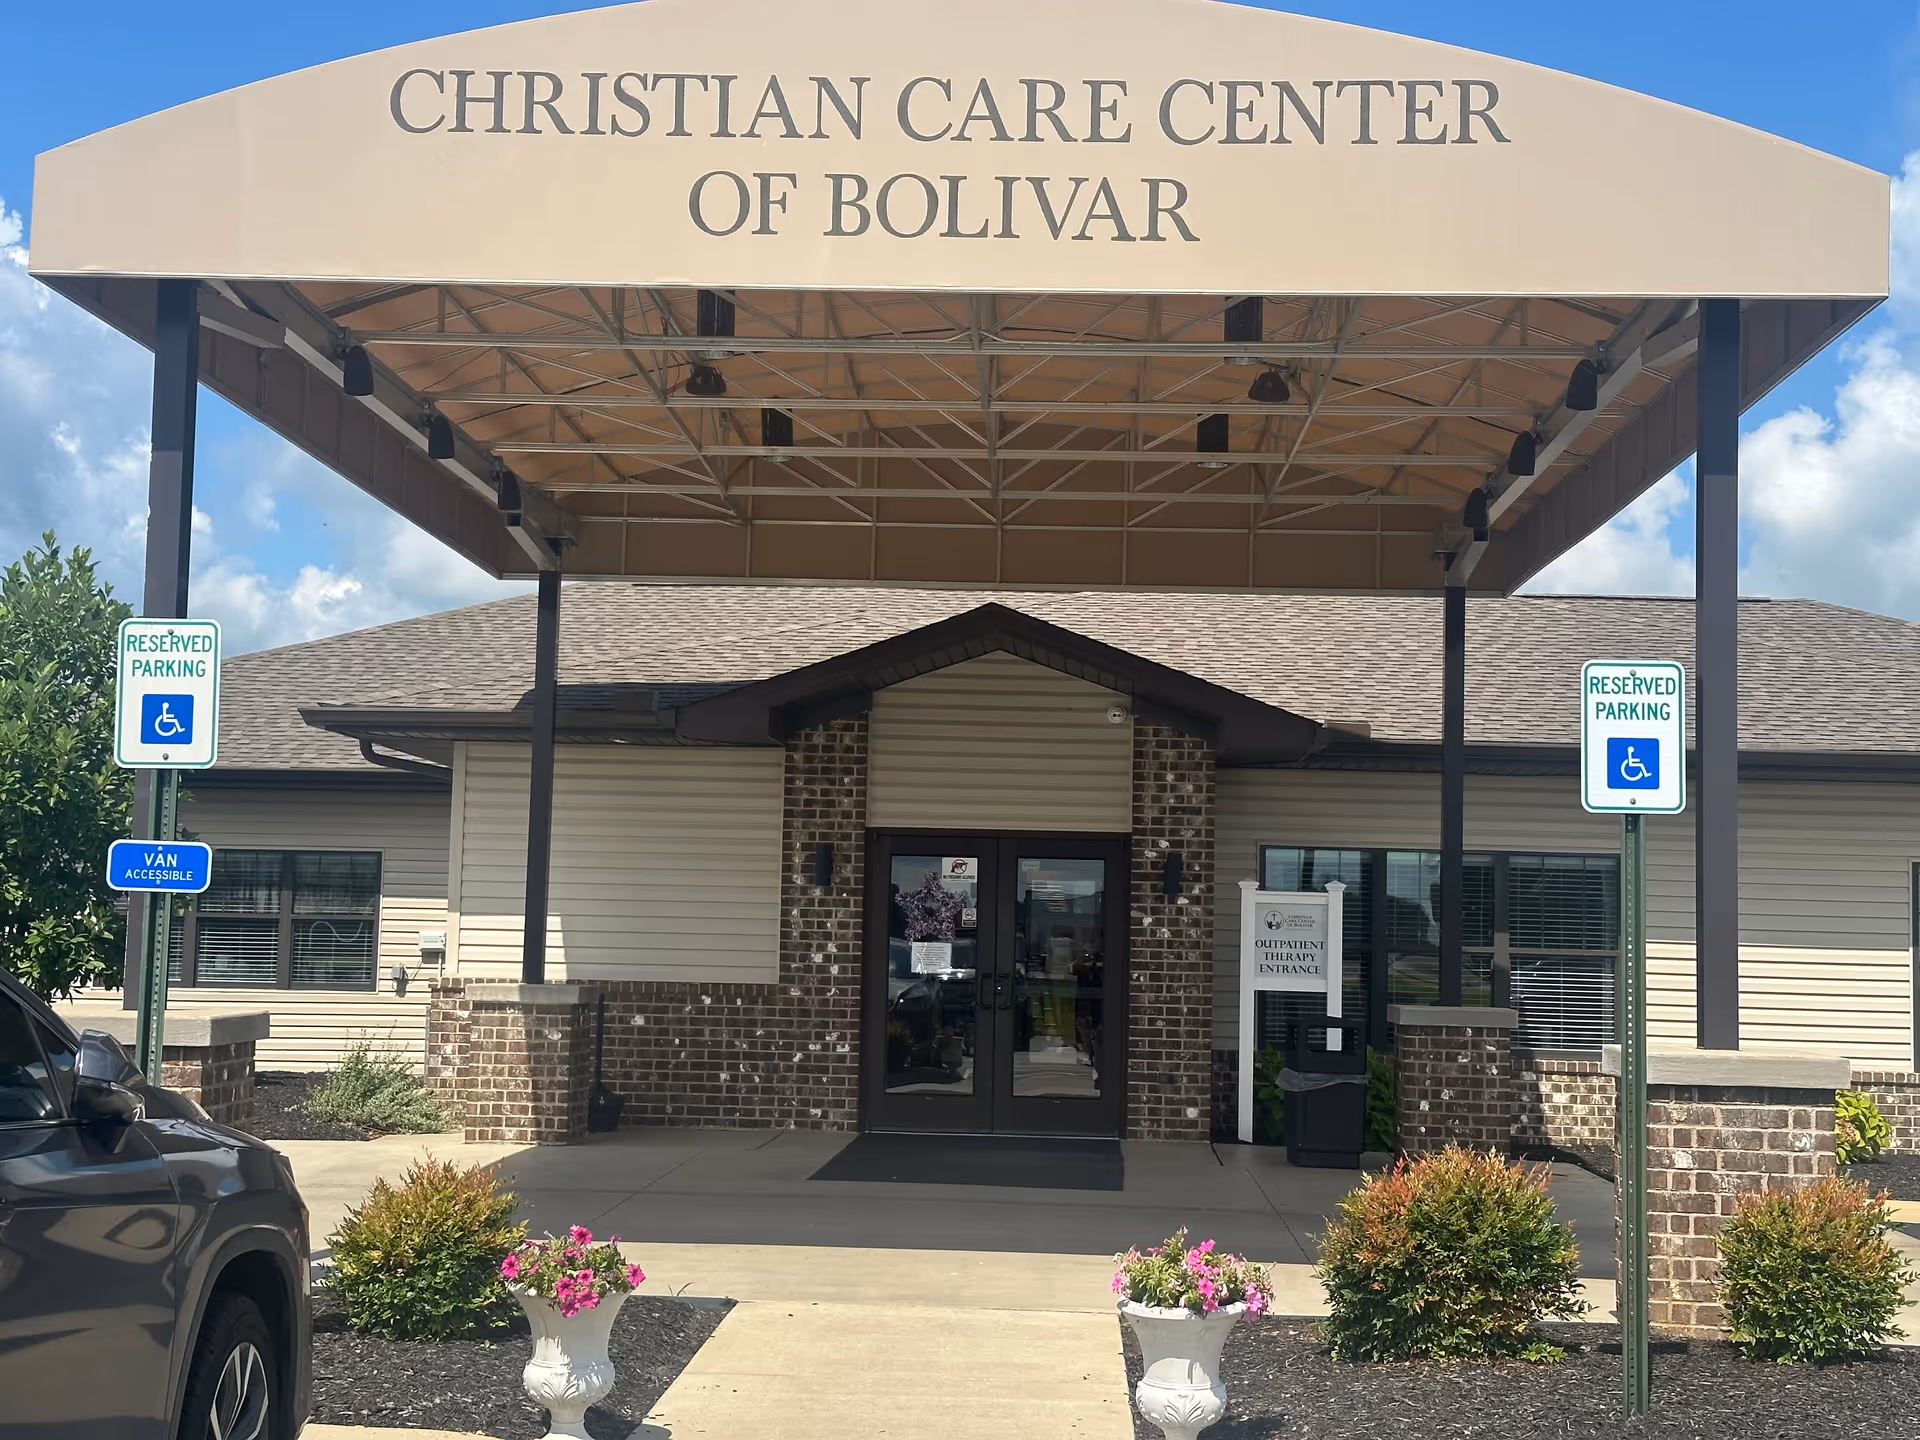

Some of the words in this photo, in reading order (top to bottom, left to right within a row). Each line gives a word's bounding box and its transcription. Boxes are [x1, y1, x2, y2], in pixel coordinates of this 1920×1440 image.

[390, 69, 870, 139] CHRISTIAN
[898, 77, 1131, 143] CARE
[1159, 79, 1511, 145] CENTER
[689, 171, 796, 236] OF
[823, 174, 1200, 241] BOLIVAR
[126, 633, 212, 652] RESERVED
[132, 659, 206, 678] PARKING
[1590, 676, 1676, 695] RESERVED
[1596, 702, 1671, 721] PARKING
[144, 853, 178, 868] VAN
[124, 868, 193, 881] ACCESSIBLE
[1255, 939, 1325, 950] OUTPATIENT
[1263, 951, 1316, 962] THERAPY
[1260, 963, 1320, 974] ENTRANCE
